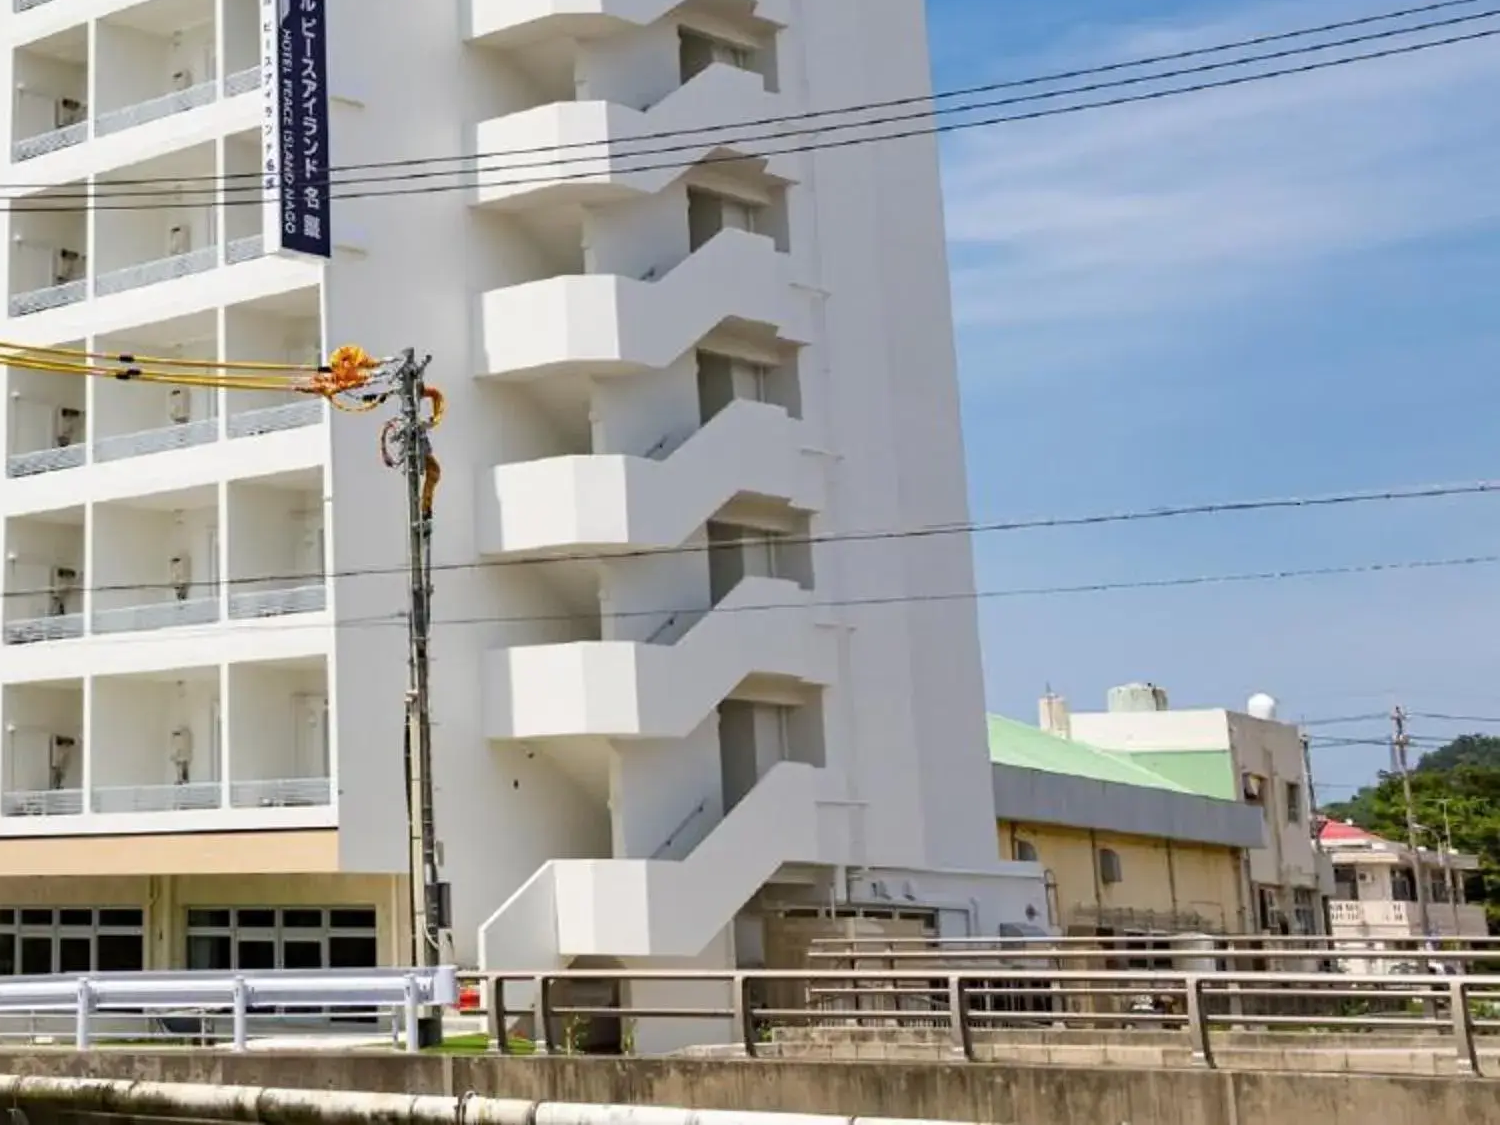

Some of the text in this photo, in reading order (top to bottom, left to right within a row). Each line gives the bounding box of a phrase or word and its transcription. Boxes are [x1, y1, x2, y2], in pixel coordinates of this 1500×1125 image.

[281, 28, 296, 234] HOTEL PEACE ISLAND NAGO
